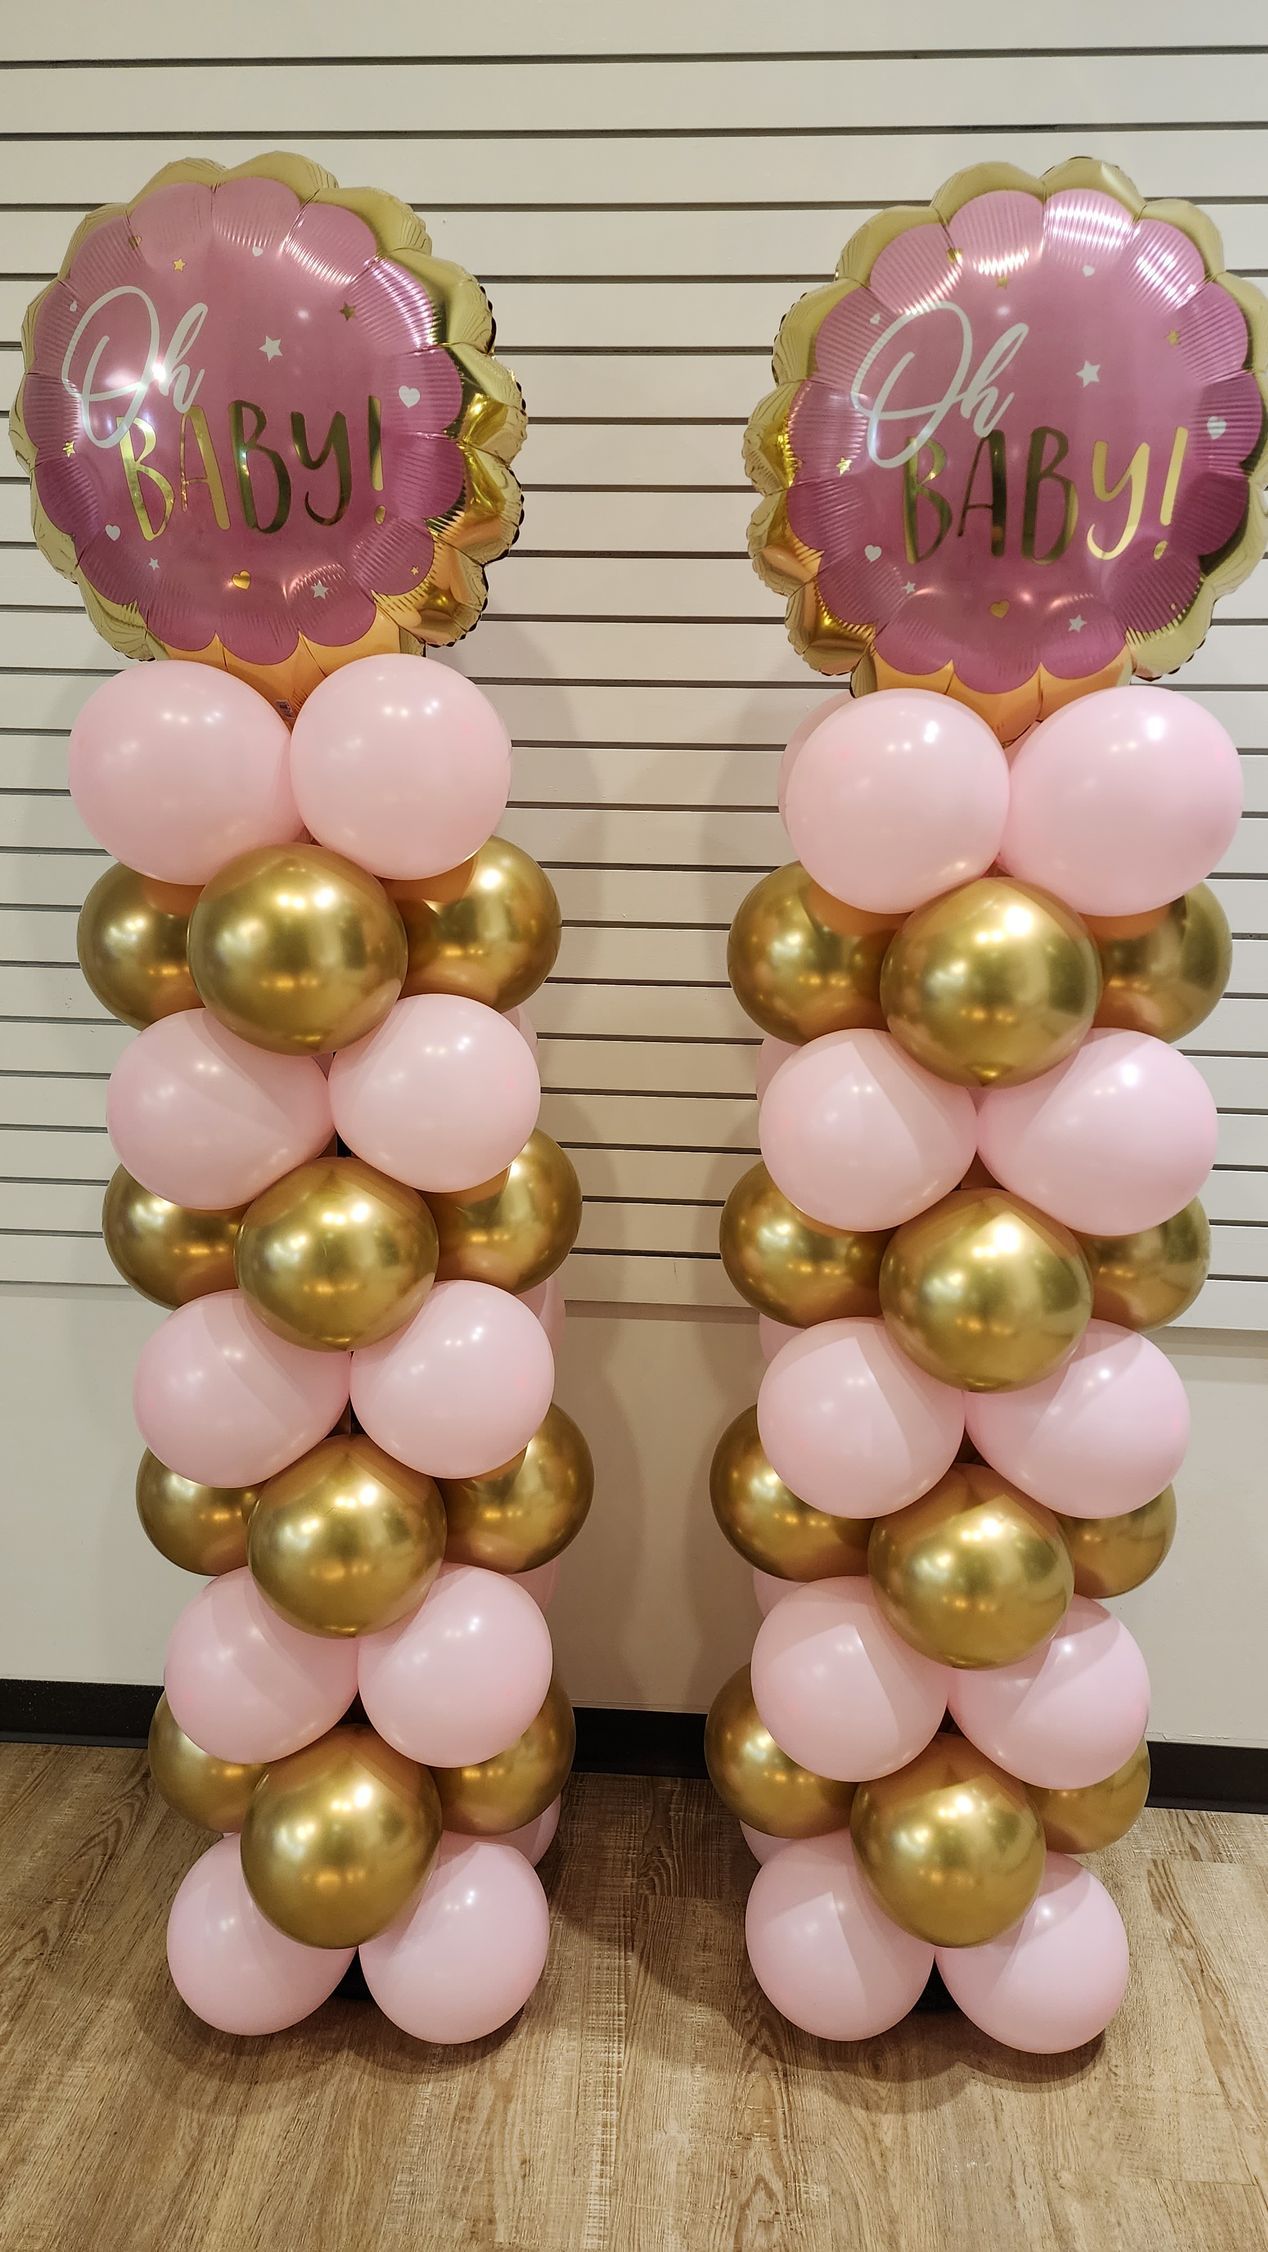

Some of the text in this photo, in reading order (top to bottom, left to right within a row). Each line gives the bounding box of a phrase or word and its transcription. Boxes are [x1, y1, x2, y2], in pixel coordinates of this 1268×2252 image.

[62, 286, 208, 448] Oh
[850, 301, 1030, 468] Oh
[116, 395, 385, 542] BABY!
[903, 426, 1189, 566] BABY!
